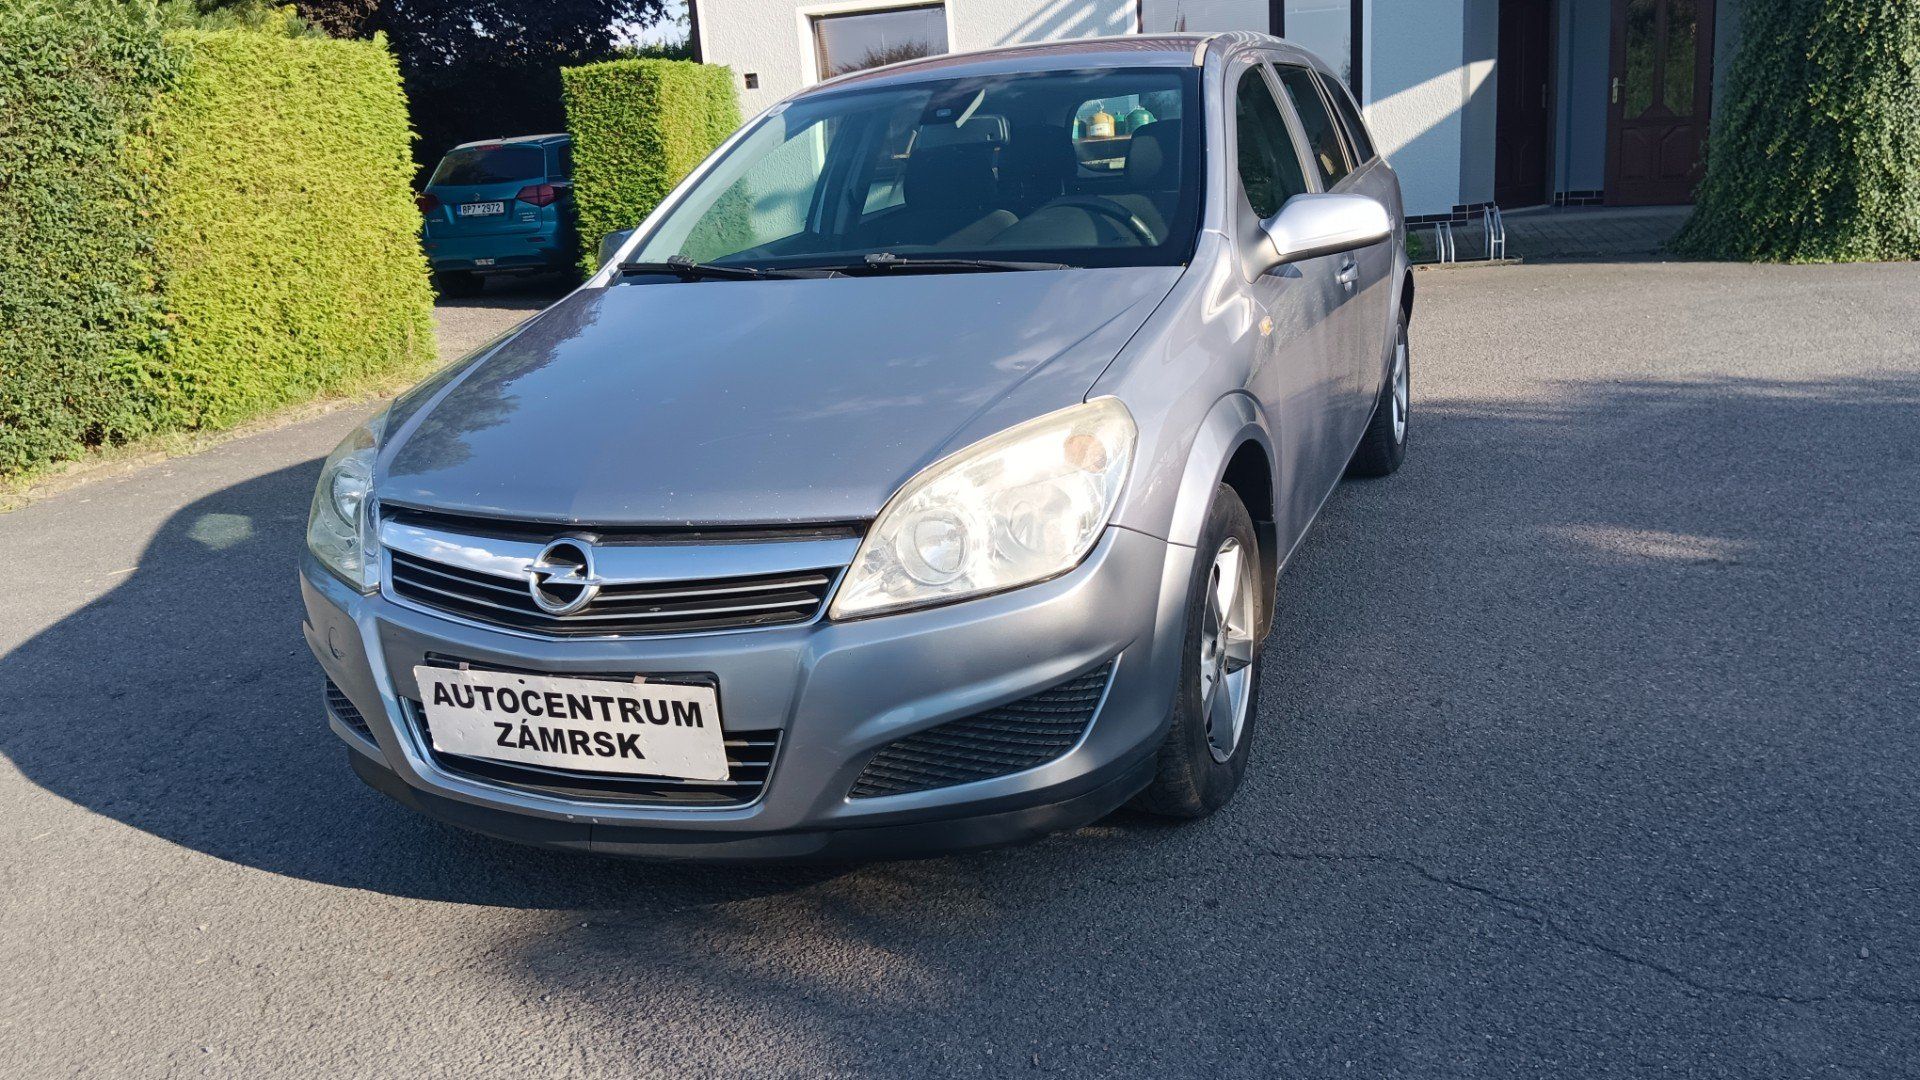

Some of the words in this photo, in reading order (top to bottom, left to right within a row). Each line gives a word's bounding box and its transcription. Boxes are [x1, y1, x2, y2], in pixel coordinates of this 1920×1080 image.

[482, 203, 501, 213] 2972
[433, 682, 704, 728] AUTOCENTRUM
[494, 718, 646, 760] ZÁMRSK
